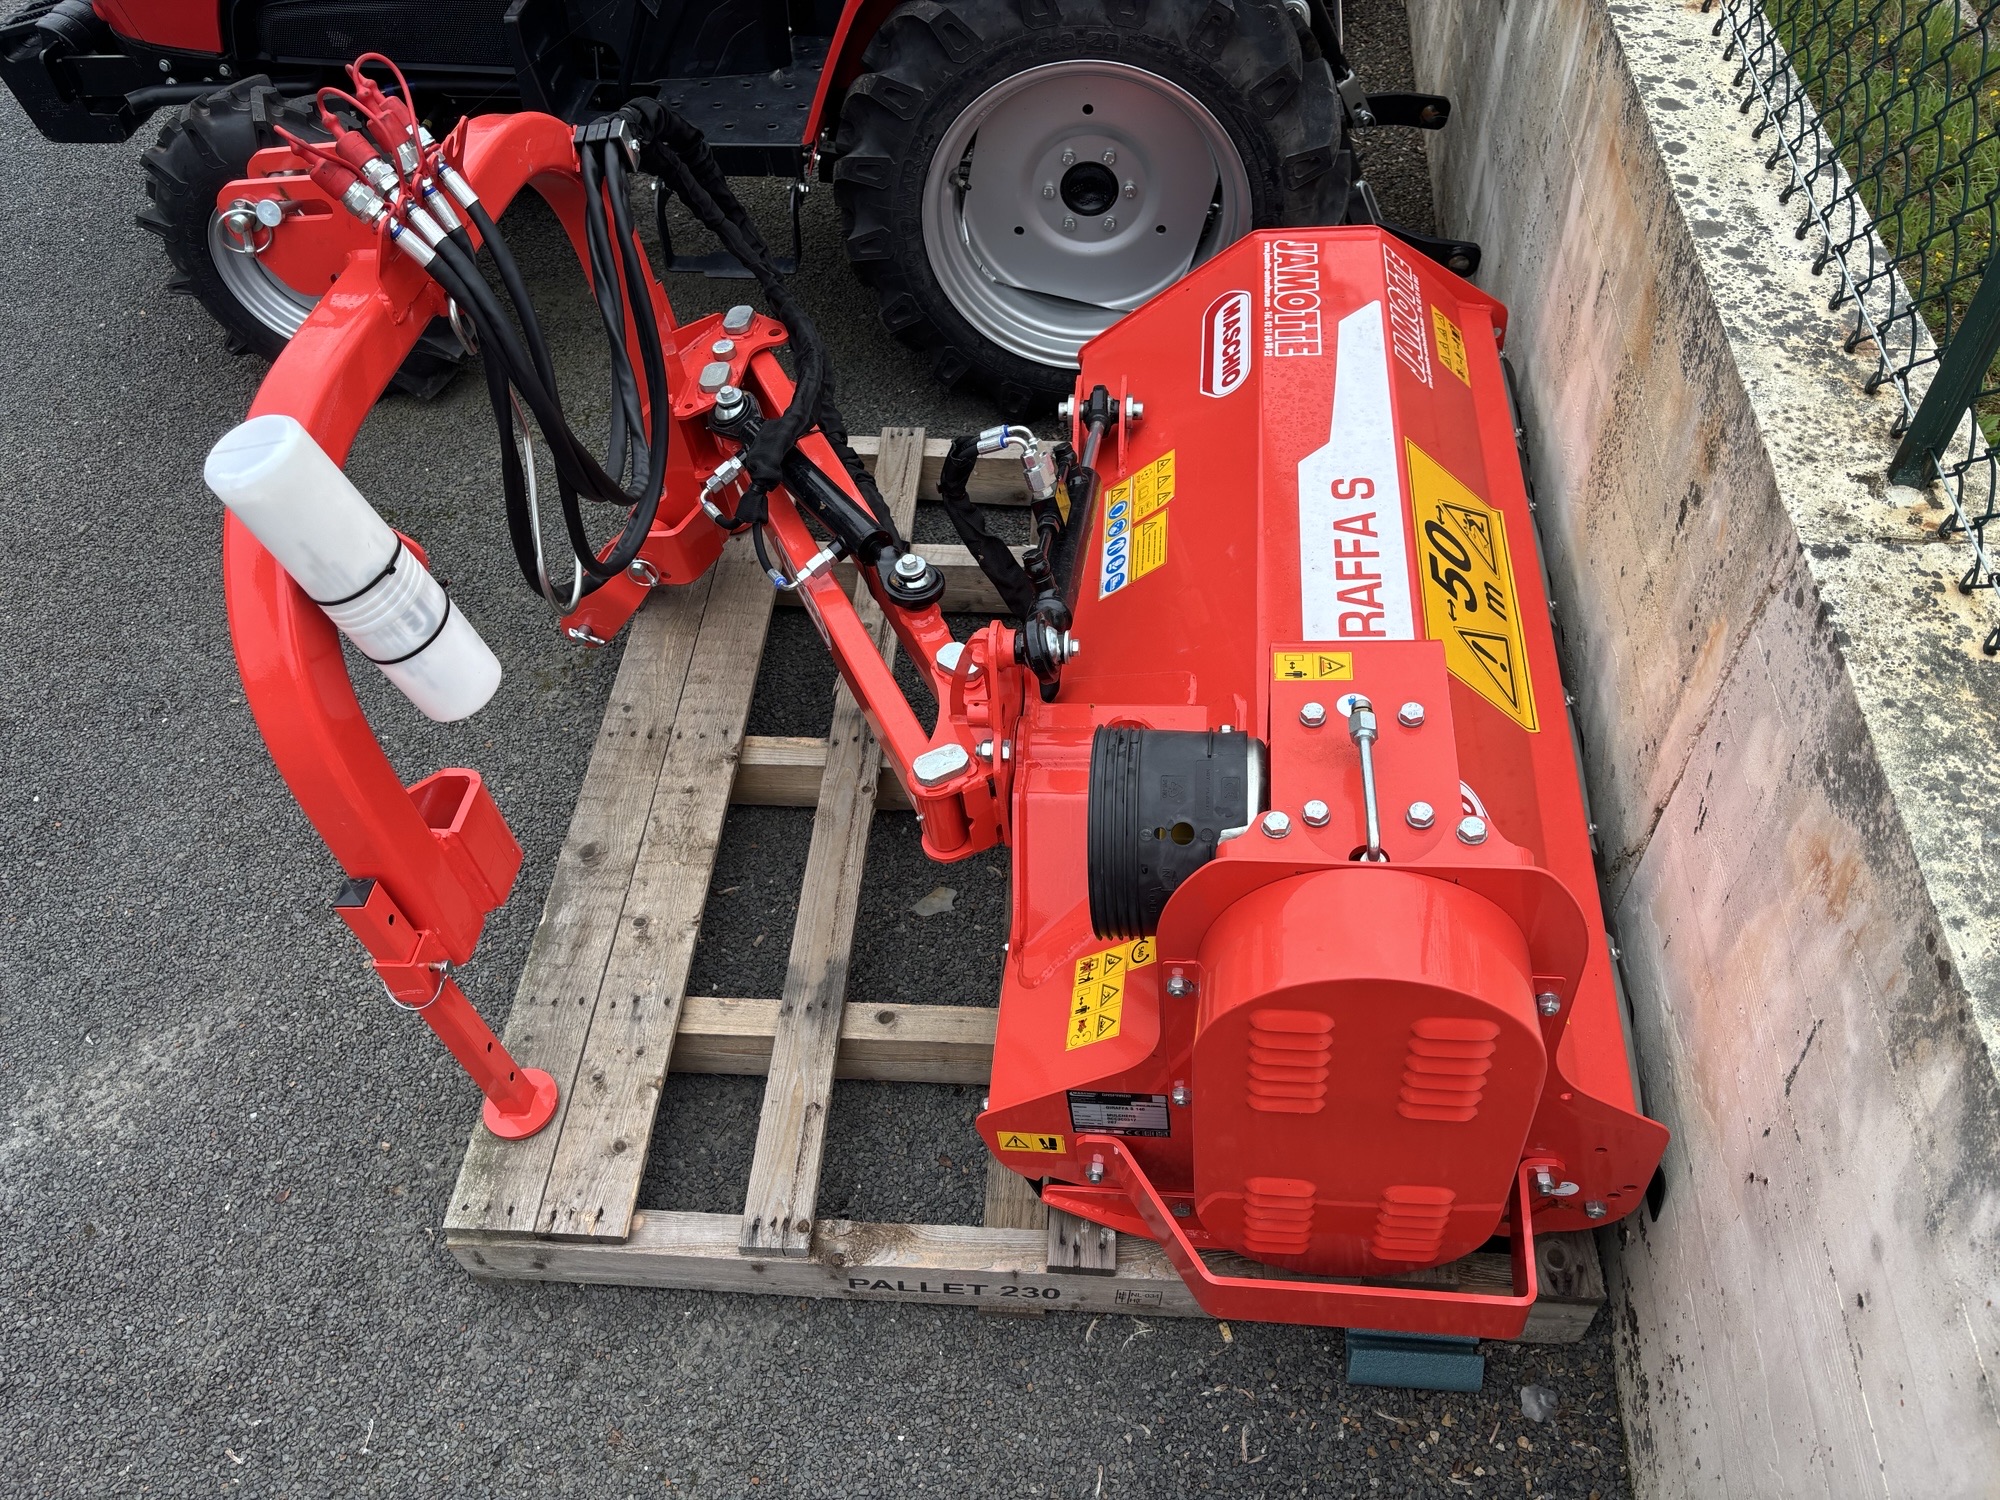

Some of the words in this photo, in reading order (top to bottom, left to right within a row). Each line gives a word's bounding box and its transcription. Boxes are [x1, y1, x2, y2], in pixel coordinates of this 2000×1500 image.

[1222, 299, 1241, 388] MASCHIO
[1273, 239, 1322, 357] JAMOTTE
[1382, 242, 1428, 383] JAMOTTE
[1331, 477, 1375, 500] S
[1333, 511, 1387, 638] RAFFA
[1424, 520, 1478, 613] 50
[1484, 581, 1508, 622] m
[848, 1278, 989, 1296] PALLET
[1000, 1285, 1061, 1300] 230
